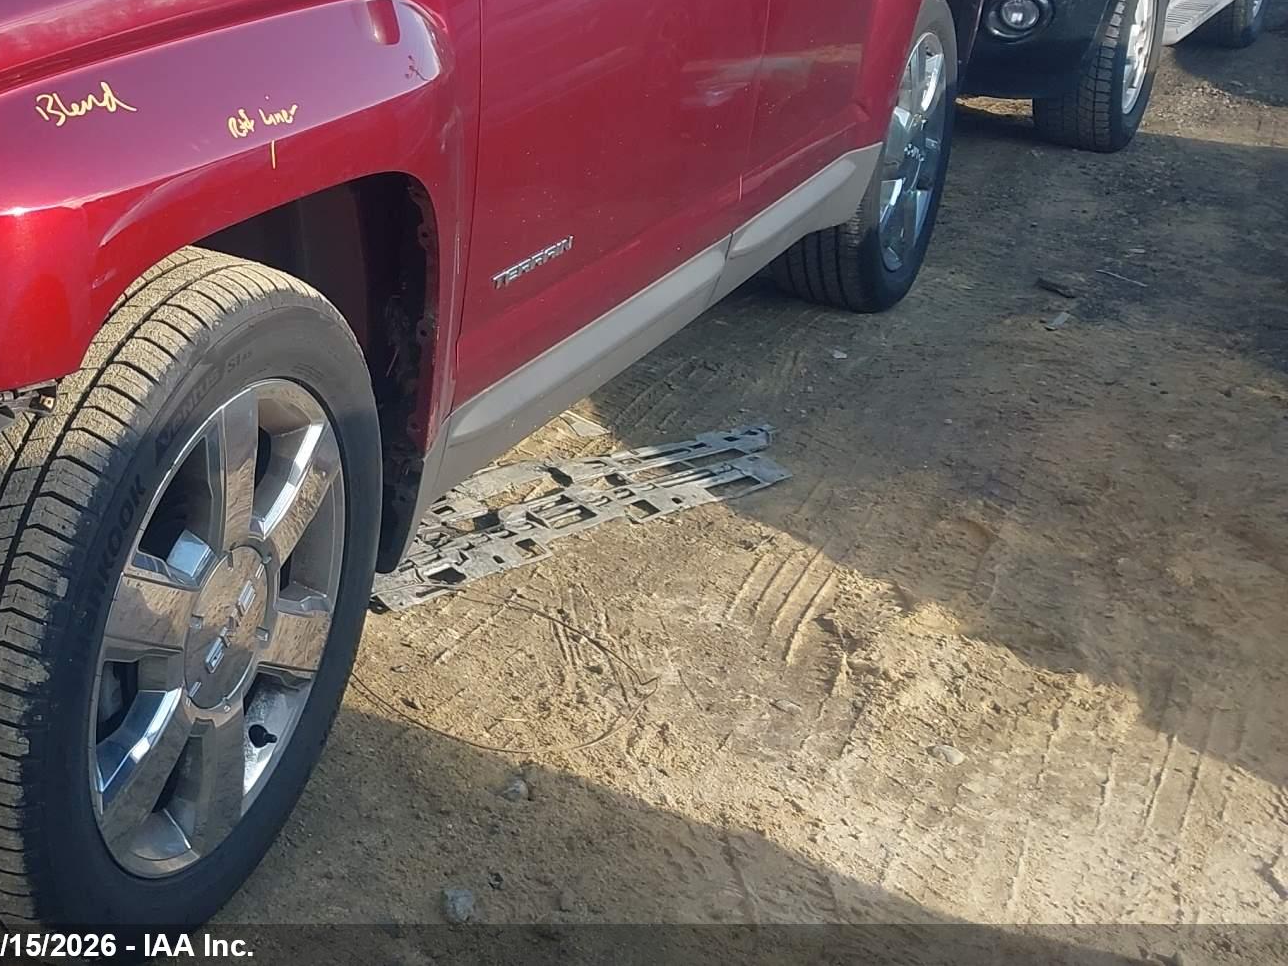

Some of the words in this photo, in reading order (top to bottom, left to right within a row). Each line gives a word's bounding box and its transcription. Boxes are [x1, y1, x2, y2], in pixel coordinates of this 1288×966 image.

[35, 81, 138, 127] Blend
[492, 234, 574, 290] TERRAIN
[205, 579, 256, 674] GMC
